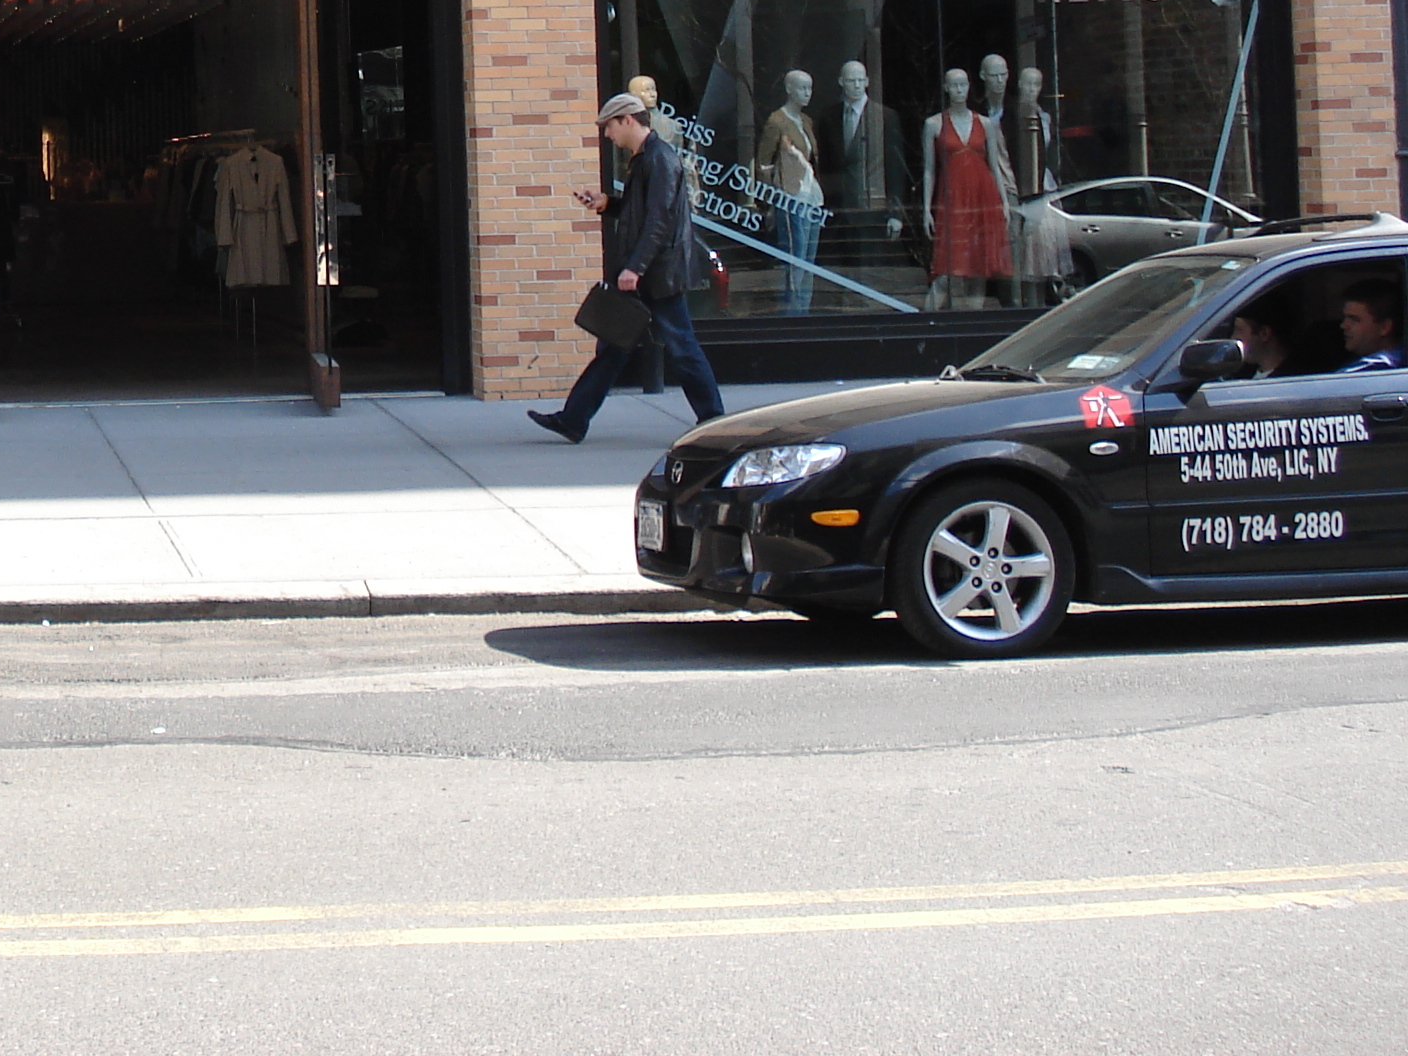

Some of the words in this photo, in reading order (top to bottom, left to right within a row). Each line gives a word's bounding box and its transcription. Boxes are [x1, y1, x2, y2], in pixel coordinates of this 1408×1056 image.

[659, 101, 716, 148] Reiss
[675, 145, 834, 228] ring/Summer
[1149, 424, 1223, 455] AMERICAN
[1227, 418, 1297, 450] SECURITY
[1180, 455, 1211, 483] 5-44
[1215, 452, 1247, 481] 50th
[1251, 450, 1282, 482] Ave,
[1284, 448, 1314, 480] LIC,
[1317, 446, 1338, 474] NY
[1182, 516, 1233, 552] (718)
[1239, 513, 1277, 542] 784
[1294, 510, 1343, 540] 2880
